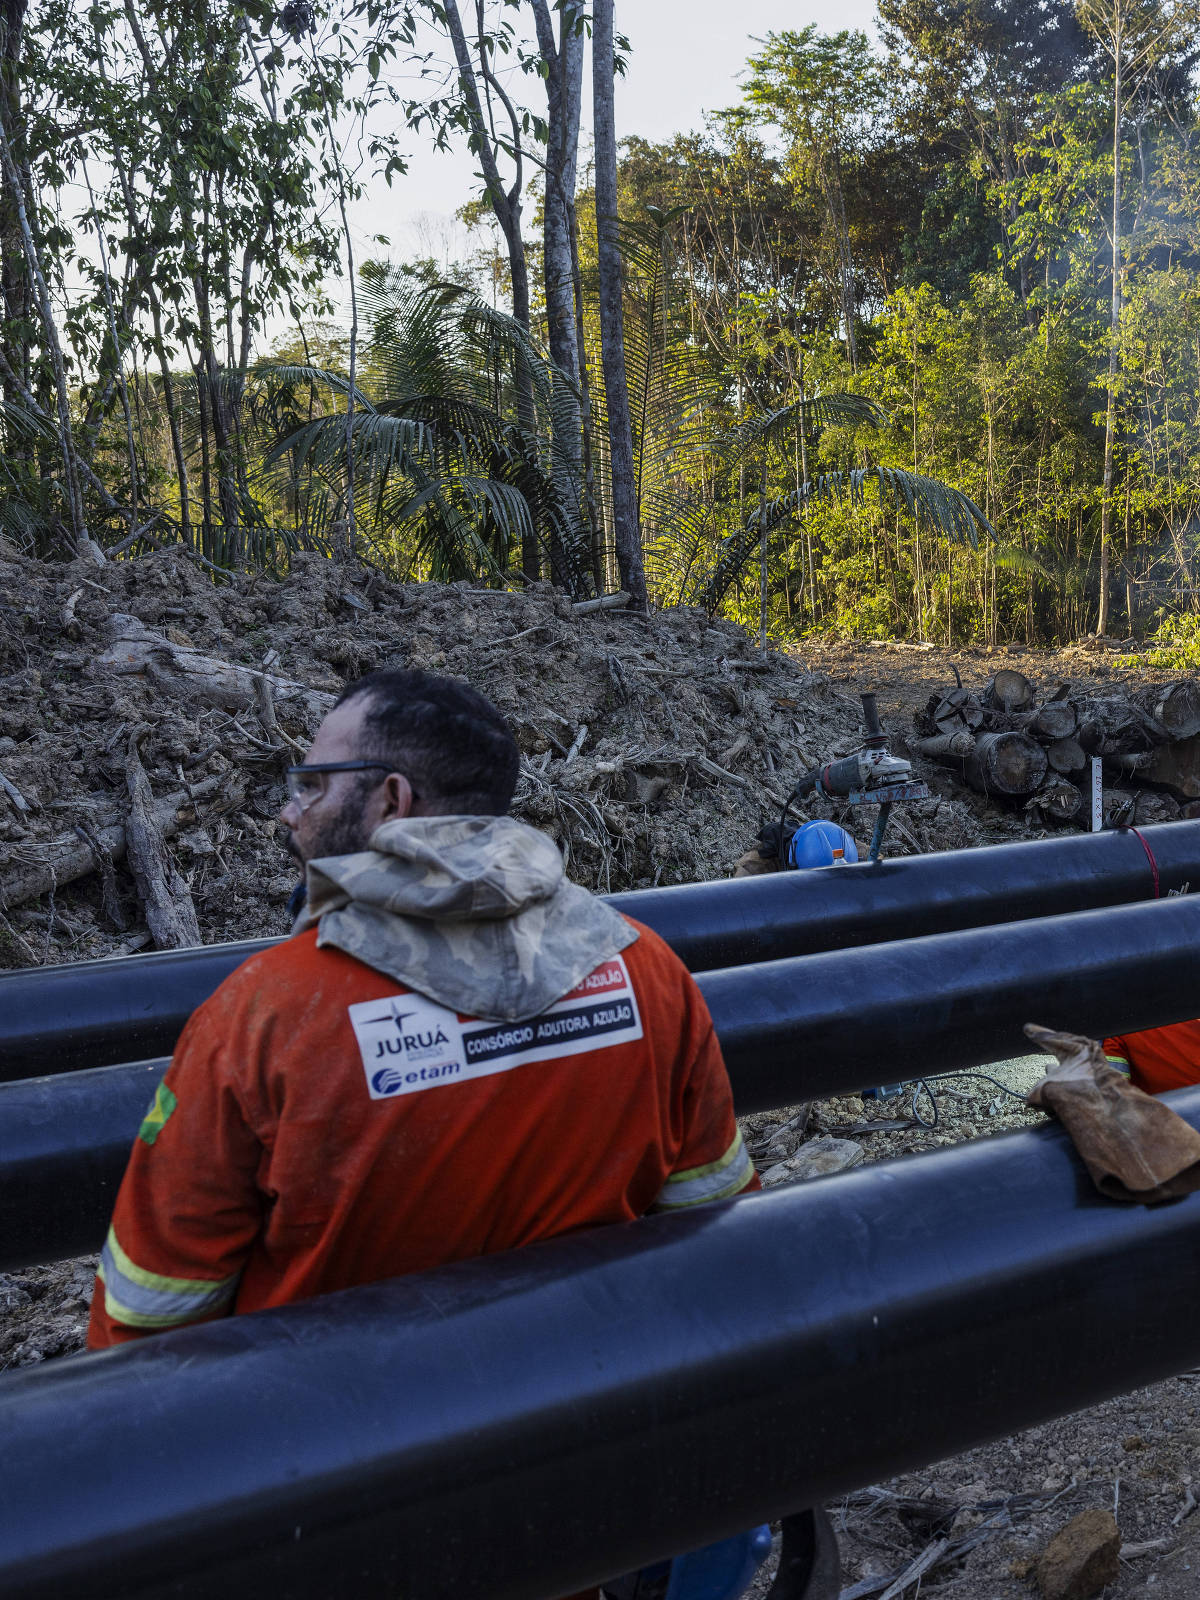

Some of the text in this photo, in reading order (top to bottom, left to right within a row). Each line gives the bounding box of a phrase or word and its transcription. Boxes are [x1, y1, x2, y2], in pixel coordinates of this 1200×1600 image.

[376, 1025, 450, 1058] JURUÁ
[467, 1025, 533, 1055] CONSÓRCIO
[537, 1015, 590, 1038] ADUTORA
[593, 1005, 632, 1027] AZULÃO
[405, 1063, 460, 1083] etam
